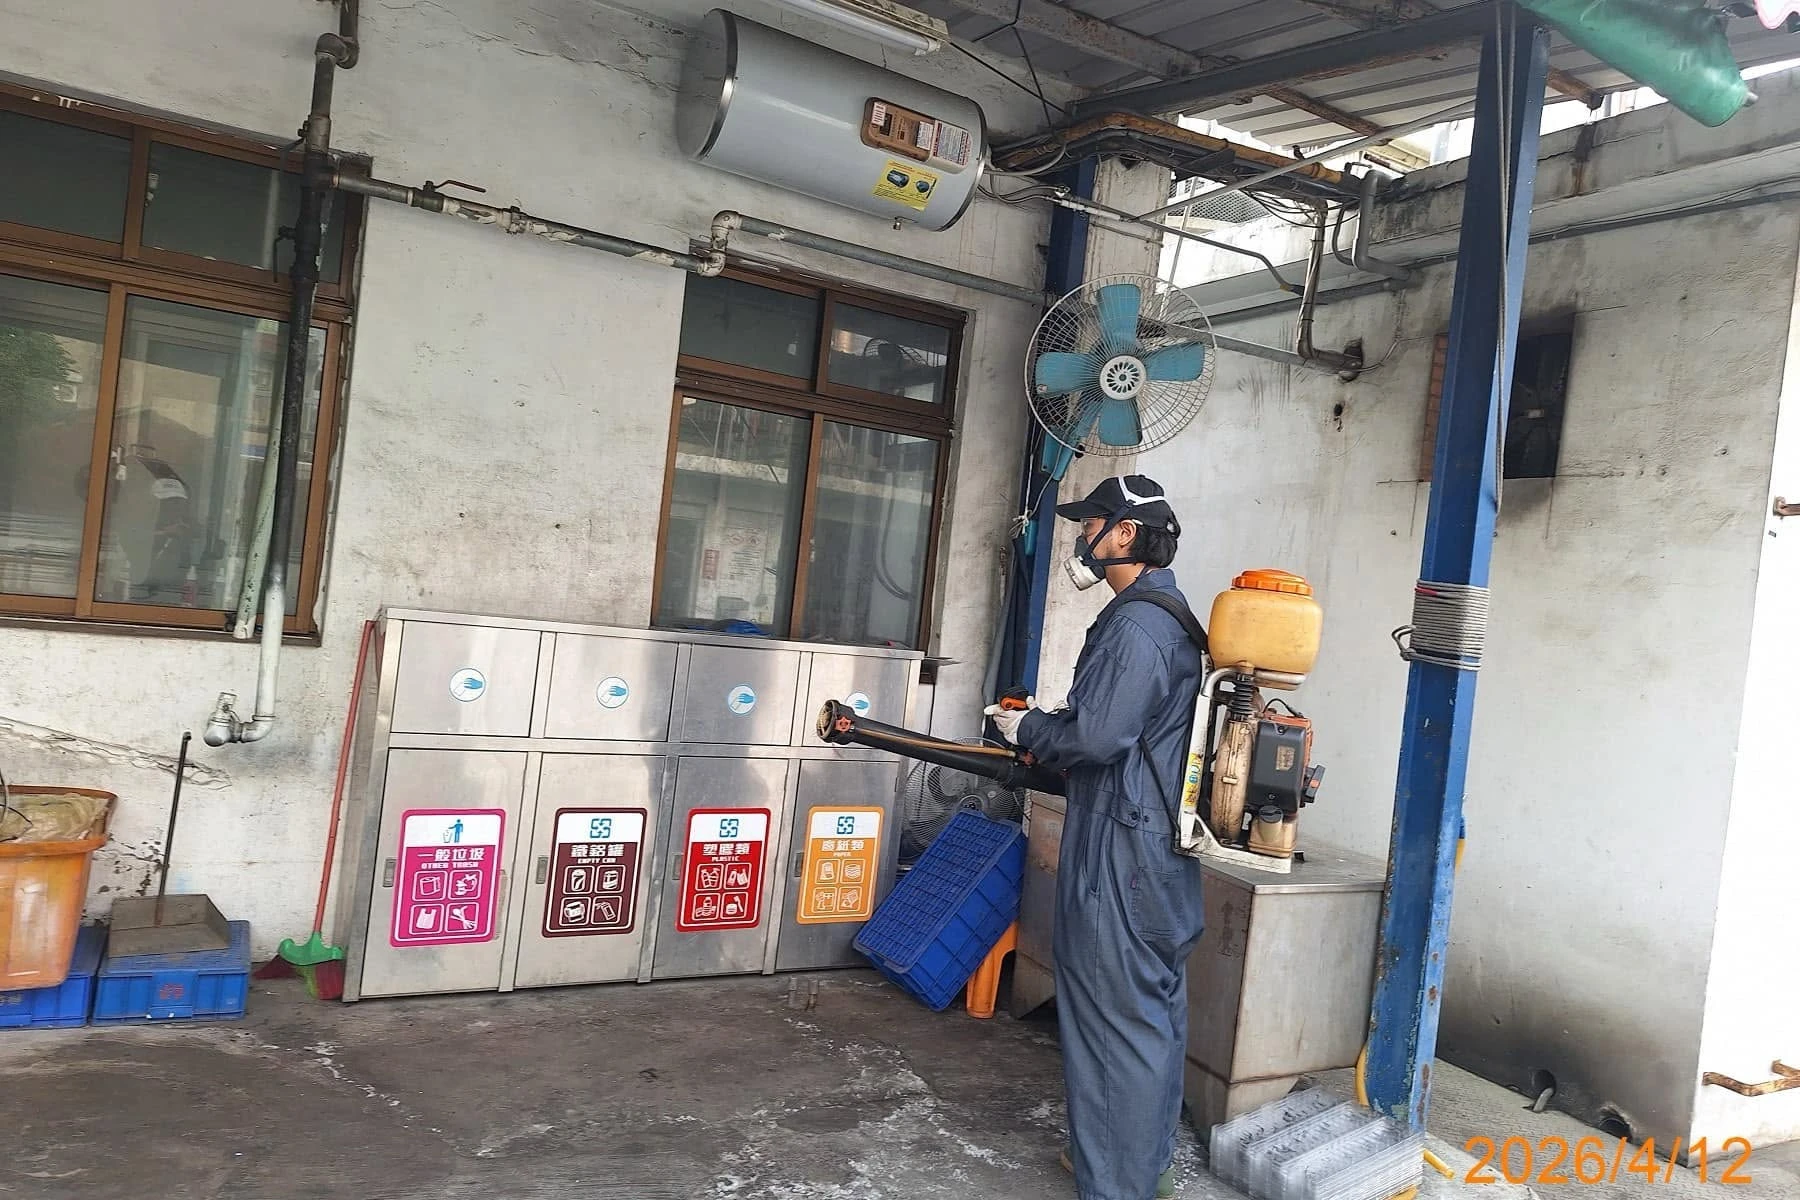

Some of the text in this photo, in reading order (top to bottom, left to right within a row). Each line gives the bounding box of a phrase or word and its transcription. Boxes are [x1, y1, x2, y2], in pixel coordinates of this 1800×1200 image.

[417, 848, 485, 861] 一般垃圾
[702, 843, 750, 856] 塑膠類
